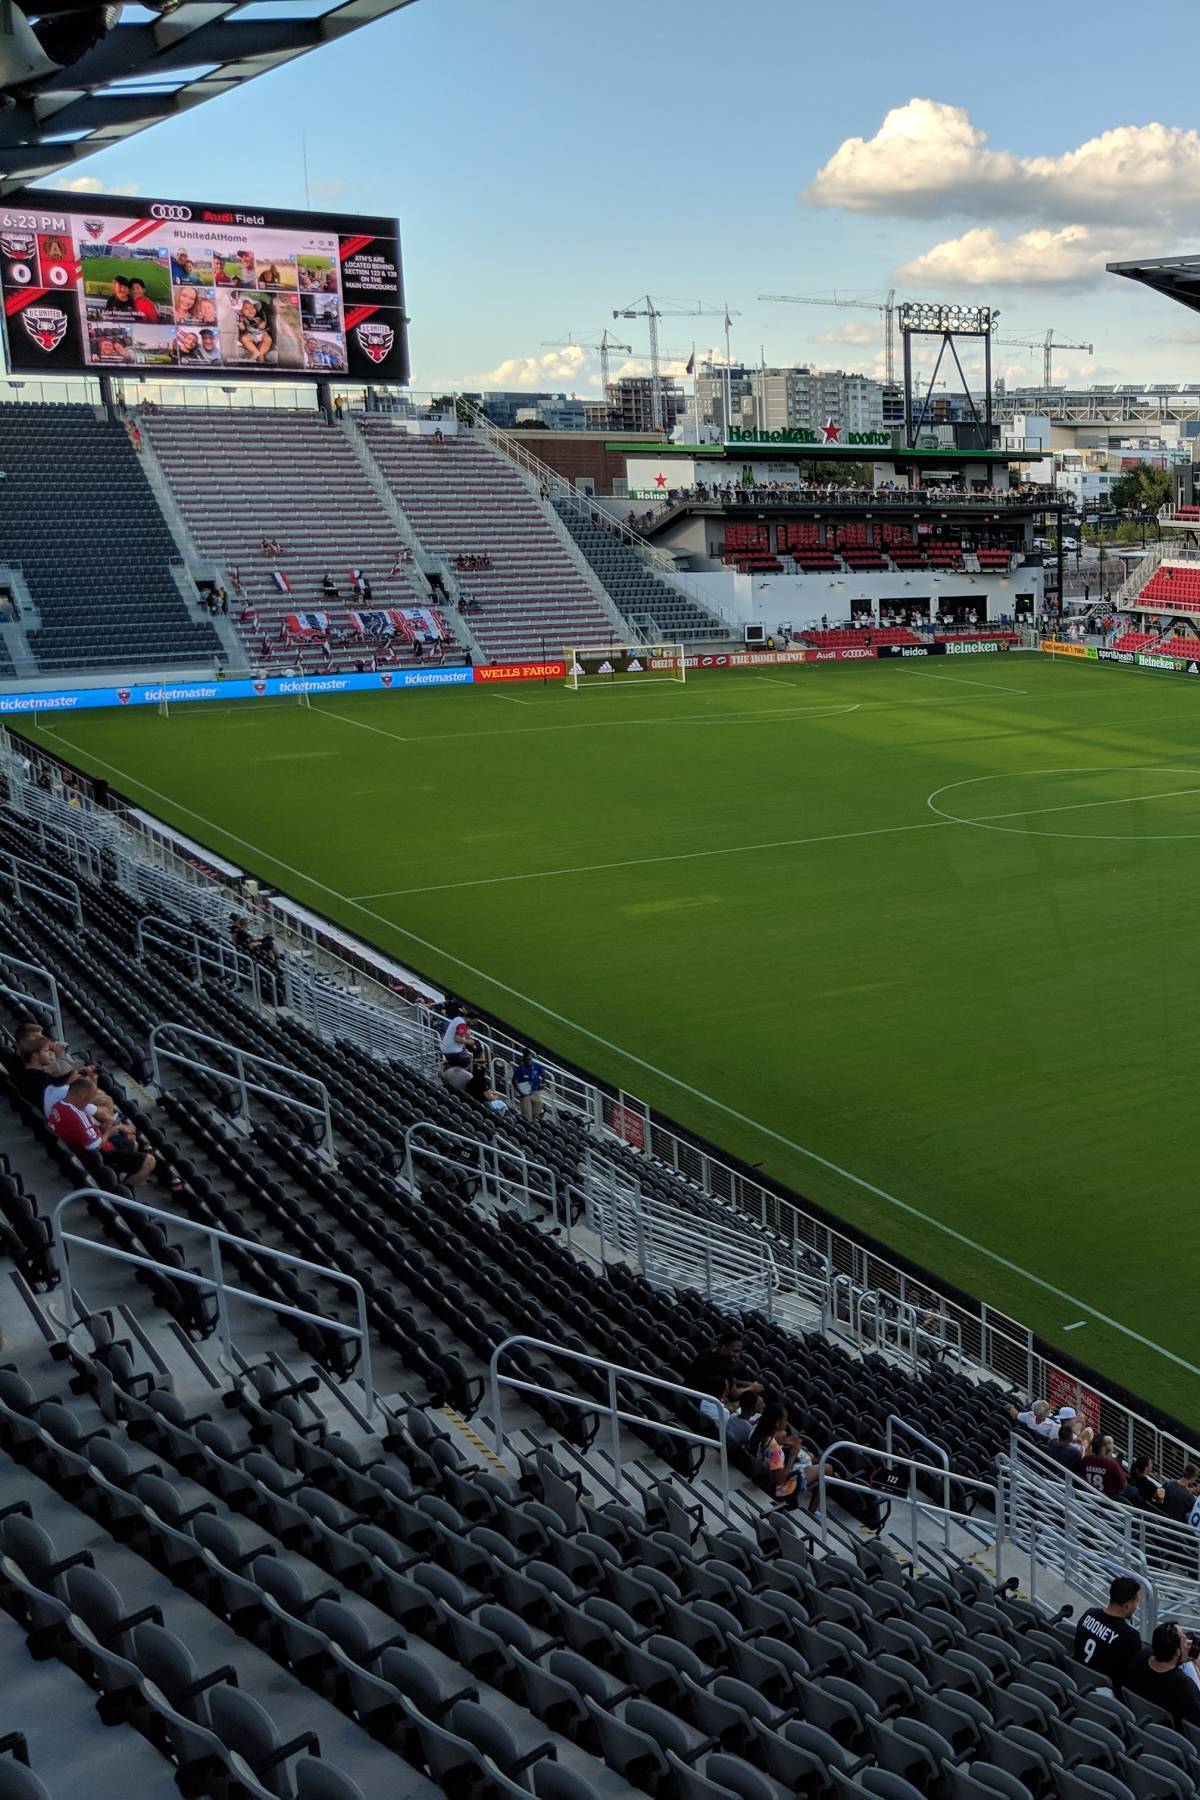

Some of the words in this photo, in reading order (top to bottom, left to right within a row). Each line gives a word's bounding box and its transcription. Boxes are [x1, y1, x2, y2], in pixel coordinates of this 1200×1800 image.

[2, 213, 37, 229] 6:23
[41, 217, 67, 232] PM
[202, 210, 234, 224] Audi
[235, 214, 265, 226] Field
[173, 229, 248, 243] #UnitedAtHome
[12, 263, 32, 284] 0
[49, 266, 69, 286] 0
[363, 283, 397, 291] CONCOURSE
[727, 424, 818, 443] Heineken
[816, 650, 836, 660] Audi
[901, 646, 929, 658] leidos
[945, 641, 998, 655] Heineken
[730, 654, 750, 665] THE
[751, 653, 776, 664] HOME
[777, 652, 805, 663] DEPOT
[1098, 650, 1134, 662] sport&health
[1138, 655, 1175, 671] Heineken
[404, 672, 468, 685] ticketmaster
[480, 667, 521, 679] WELLS
[523, 665, 561, 677] FARGO
[279, 680, 348, 693] ticketmaster
[144, 687, 218, 701] ticketmaster
[1083, 1614, 1120, 1645] ROONEY
[1084, 1638, 1097, 1664] 9
